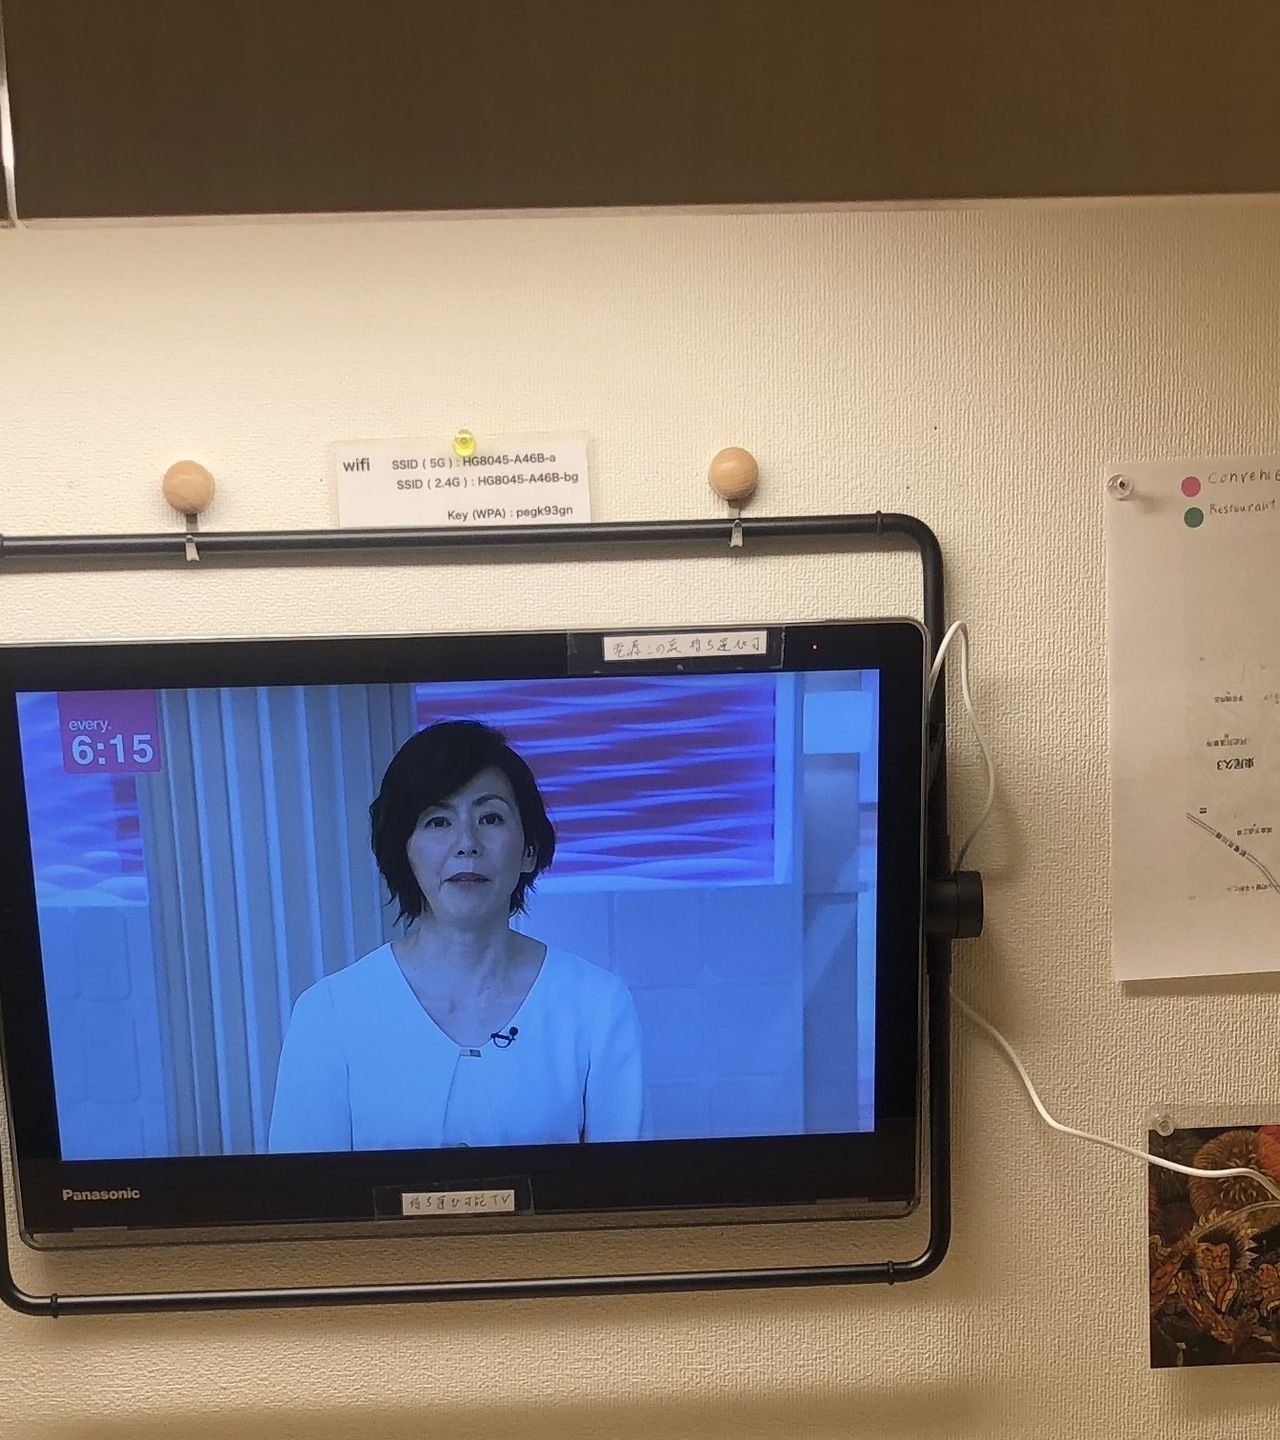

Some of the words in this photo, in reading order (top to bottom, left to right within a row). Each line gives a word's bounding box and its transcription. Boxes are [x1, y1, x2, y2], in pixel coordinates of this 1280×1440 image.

[343, 457, 371, 472] wifi
[392, 459, 419, 471] SSID
[430, 459, 446, 470] 5G
[463, 453, 557, 468] HG8045-A46B-a
[397, 478, 424, 490] SSID
[435, 477, 461, 489] 2.4G
[477, 472, 579, 488] HG8045-A46B-bg
[1210, 499, 1276, 515] Restaurant
[447, 509, 469, 523] Key
[472, 508, 507, 520] (WPA)
[68, 720, 112, 733] every.
[72, 734, 153, 765] 6:15
[62, 1187, 141, 1201] Panasonic
